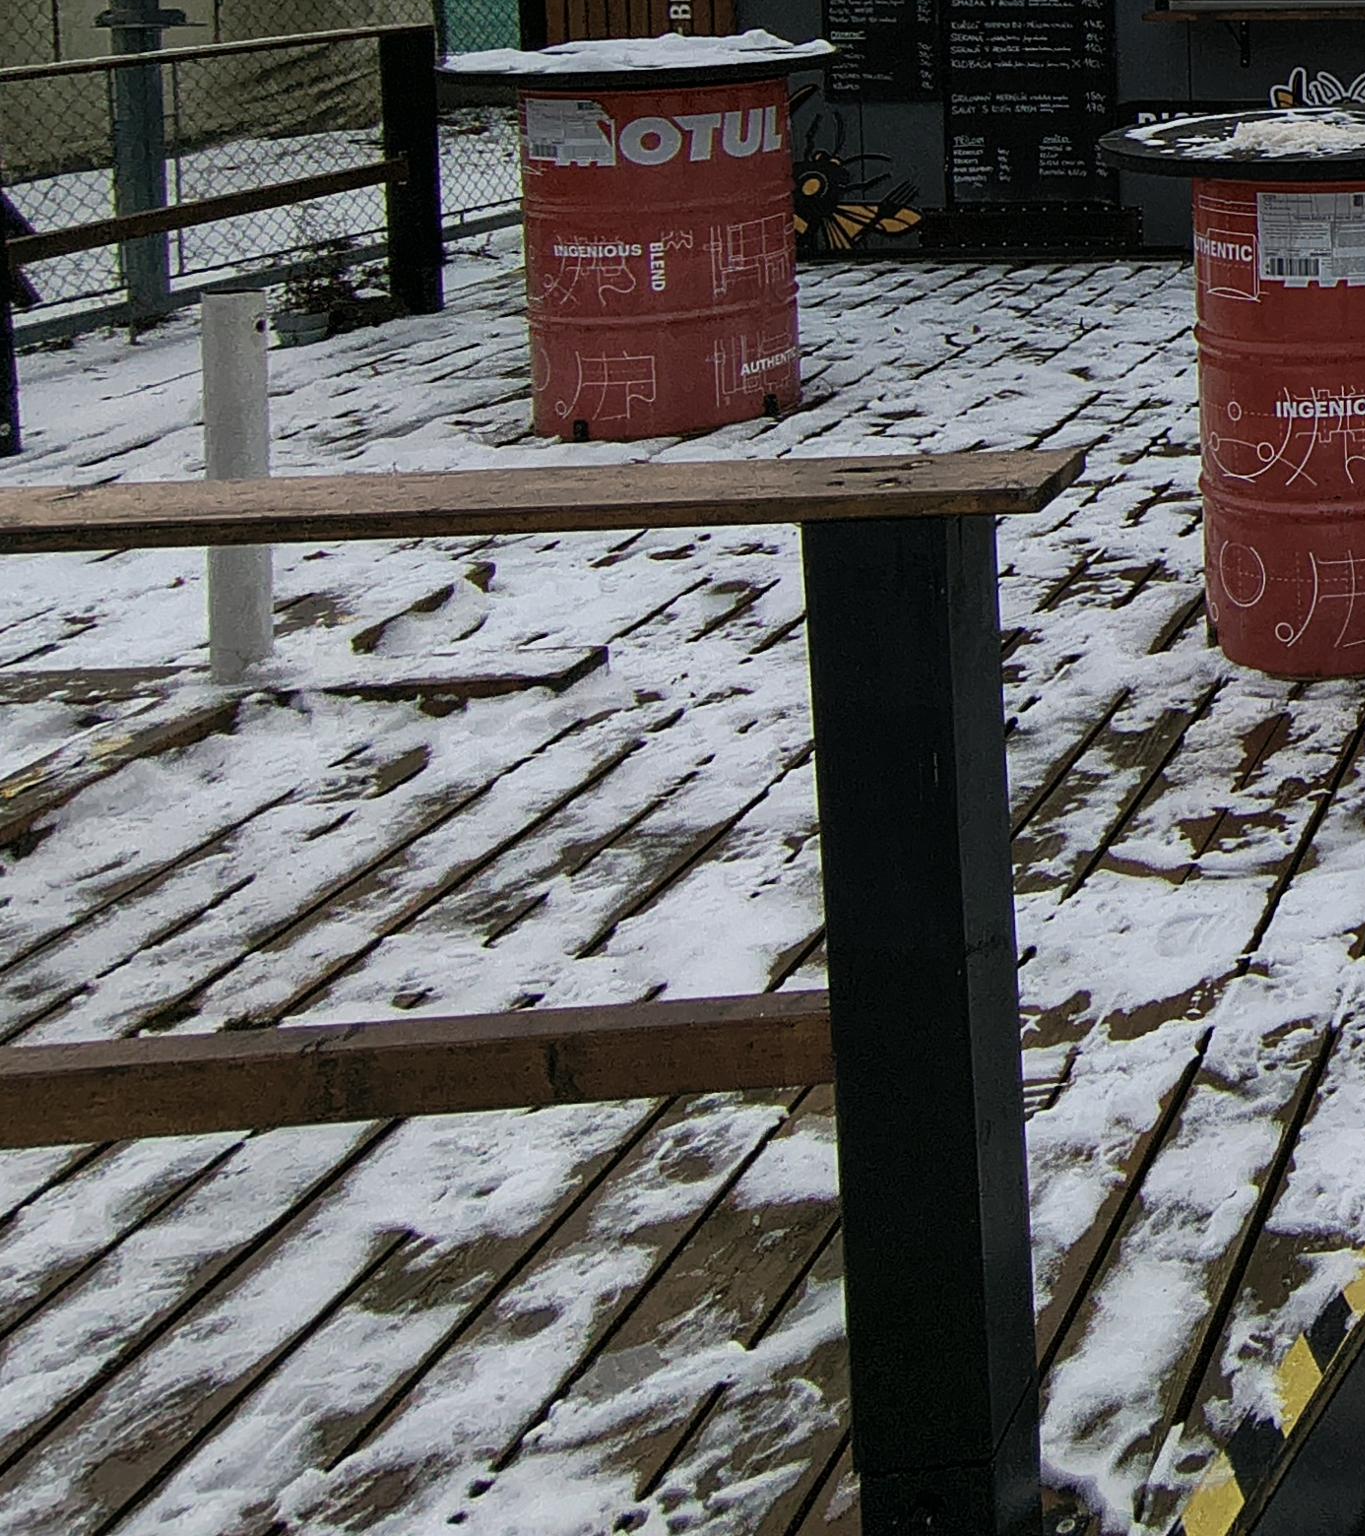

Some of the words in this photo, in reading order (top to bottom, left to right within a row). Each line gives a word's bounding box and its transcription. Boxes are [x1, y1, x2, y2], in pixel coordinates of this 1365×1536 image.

[554, 243, 643, 258] INGENIOUS
[649, 242, 666, 292] BLEND
[1194, 234, 1254, 262] UTHENTIC
